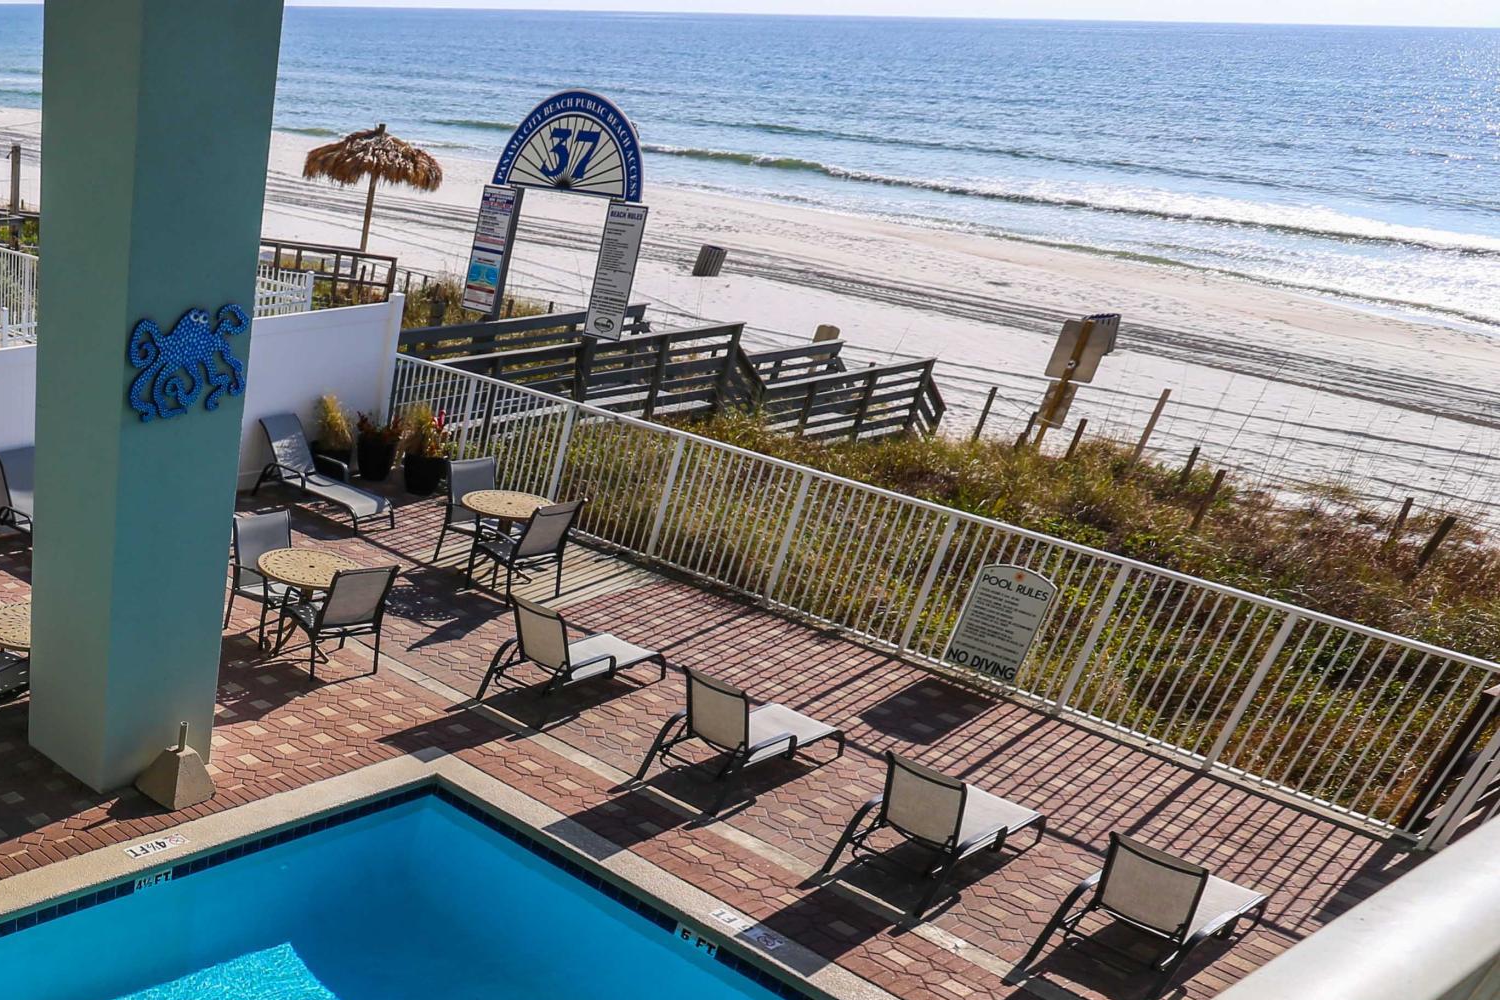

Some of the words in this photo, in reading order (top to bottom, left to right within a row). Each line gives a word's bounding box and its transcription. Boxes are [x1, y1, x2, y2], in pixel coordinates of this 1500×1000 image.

[497, 134, 523, 180] PANAMA
[523, 112, 543, 134] CITY
[543, 98, 574, 116] BEACH
[575, 97, 609, 118] PUBLIC
[606, 113, 632, 149] BEACH
[625, 150, 638, 197] ACCESS
[540, 127, 602, 179] 37
[610, 210, 627, 218] BEACH
[627, 212, 643, 220] RULES
[982, 574, 1012, 591] POOL
[1015, 584, 1049, 602] RULES
[947, 647, 969, 663] NO
[970, 655, 1016, 680] DIVING
